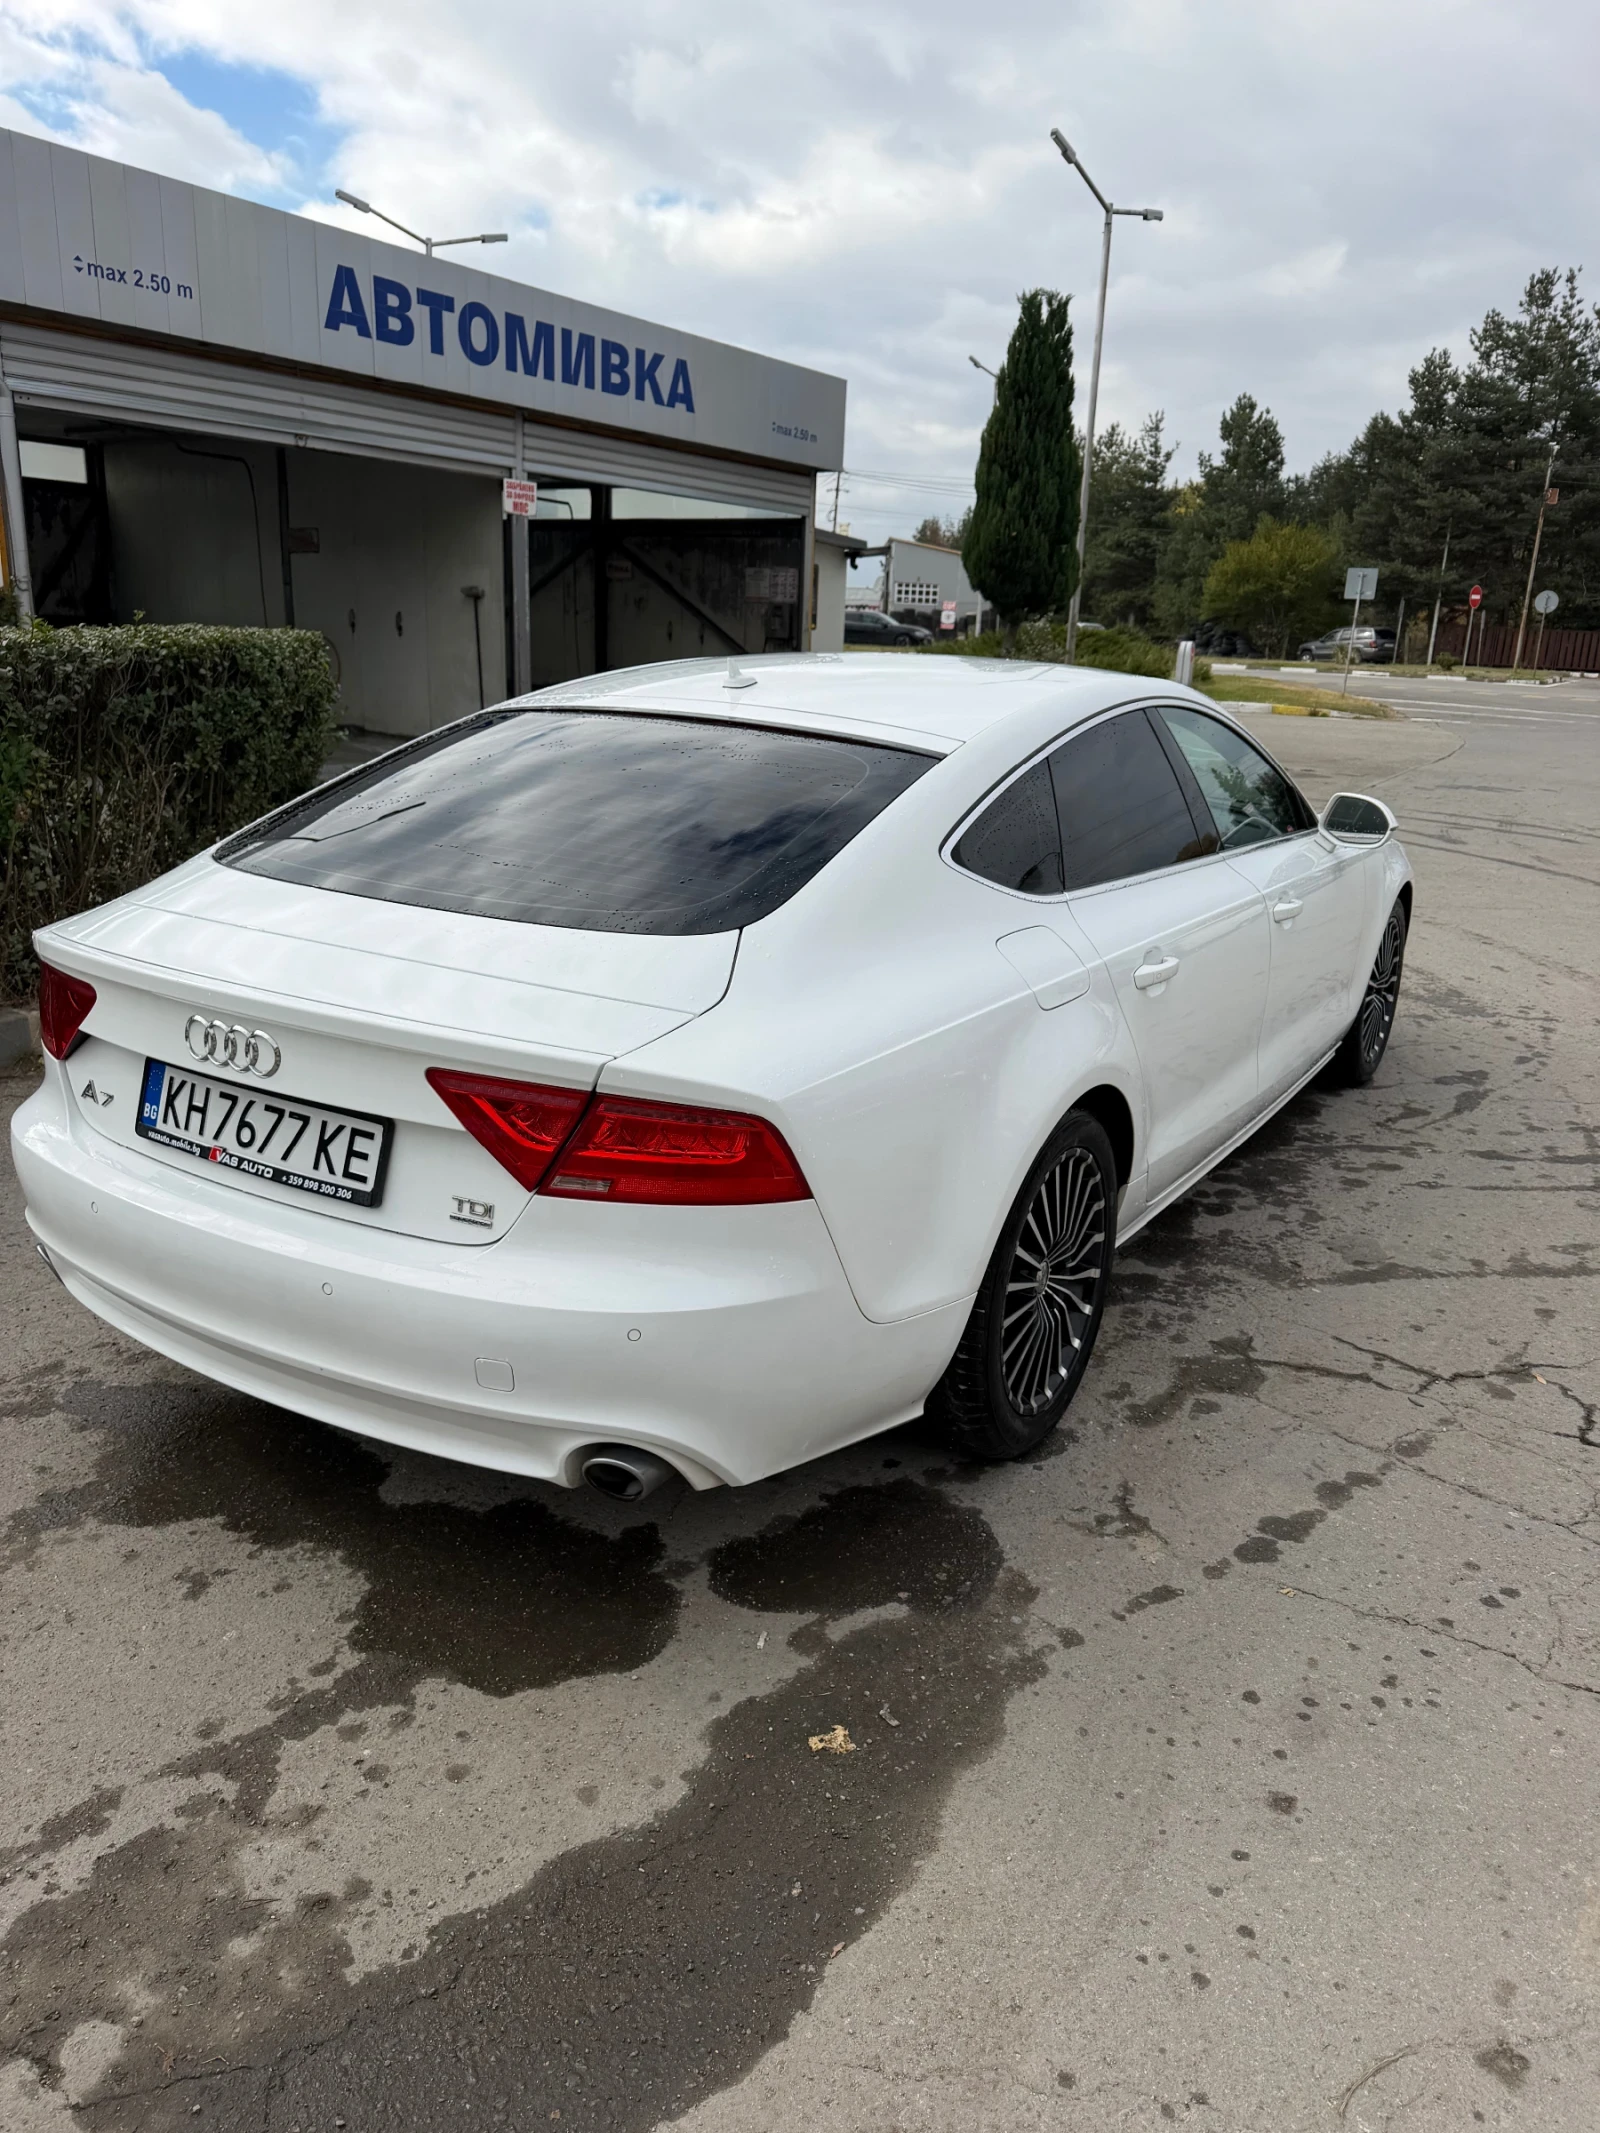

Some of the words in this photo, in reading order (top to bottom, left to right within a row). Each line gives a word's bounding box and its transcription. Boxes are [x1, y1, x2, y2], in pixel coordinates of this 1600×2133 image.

[87, 262, 128, 284] max
[133, 269, 171, 294] 2.50
[177, 283, 193, 299] m
[324, 264, 695, 414] АВТОМИВКА
[776, 425, 792, 436] max
[793, 426, 809, 441] 2.50
[81, 1079, 115, 1107] A7
[143, 1102, 158, 1119] BG
[148, 1130, 201, 1156] vasauto.mobile.bg
[215, 1147, 239, 1167] VAS
[240, 1160, 274, 1178] AUTO
[303, 1179, 319, 1191] 898
[319, 1184, 335, 1195] 300
[336, 1187, 352, 1199] 306
[451, 1195, 495, 1220] TDI
